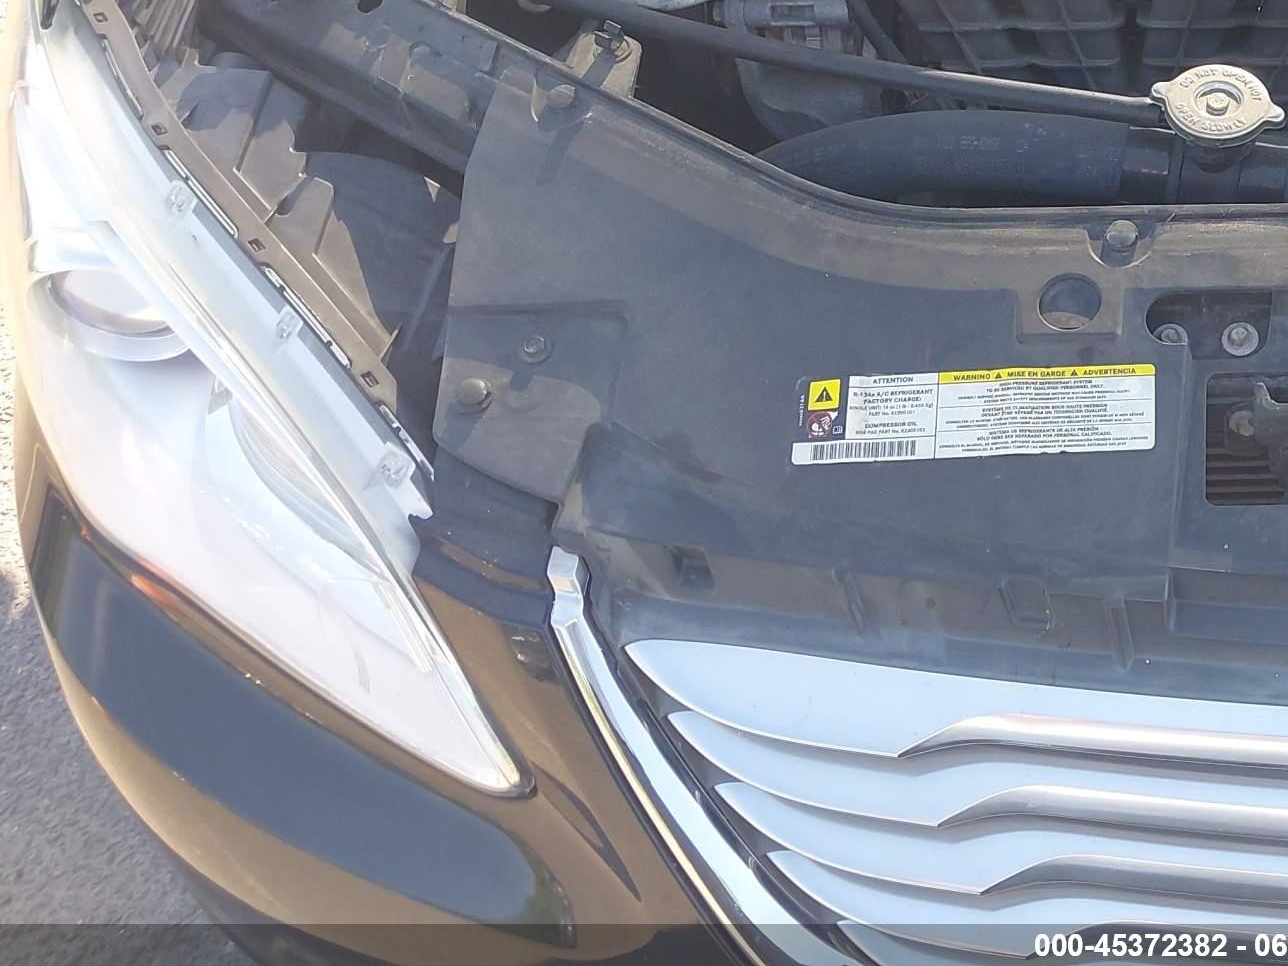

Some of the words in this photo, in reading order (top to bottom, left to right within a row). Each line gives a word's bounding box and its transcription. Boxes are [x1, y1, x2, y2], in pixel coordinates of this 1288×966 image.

[1195, 68, 1217, 80] NOT
[1222, 69, 1252, 87] OPEN
[1175, 104, 1201, 126] OPEN
[1201, 116, 1247, 132] SLOWLY
[953, 373, 991, 382] WARNING
[1007, 370, 1027, 378] MISE
[1040, 370, 1066, 378] GARDE
[1083, 368, 1137, 376] ADVERTENCIA
[863, 397, 893, 405] FACTORY
